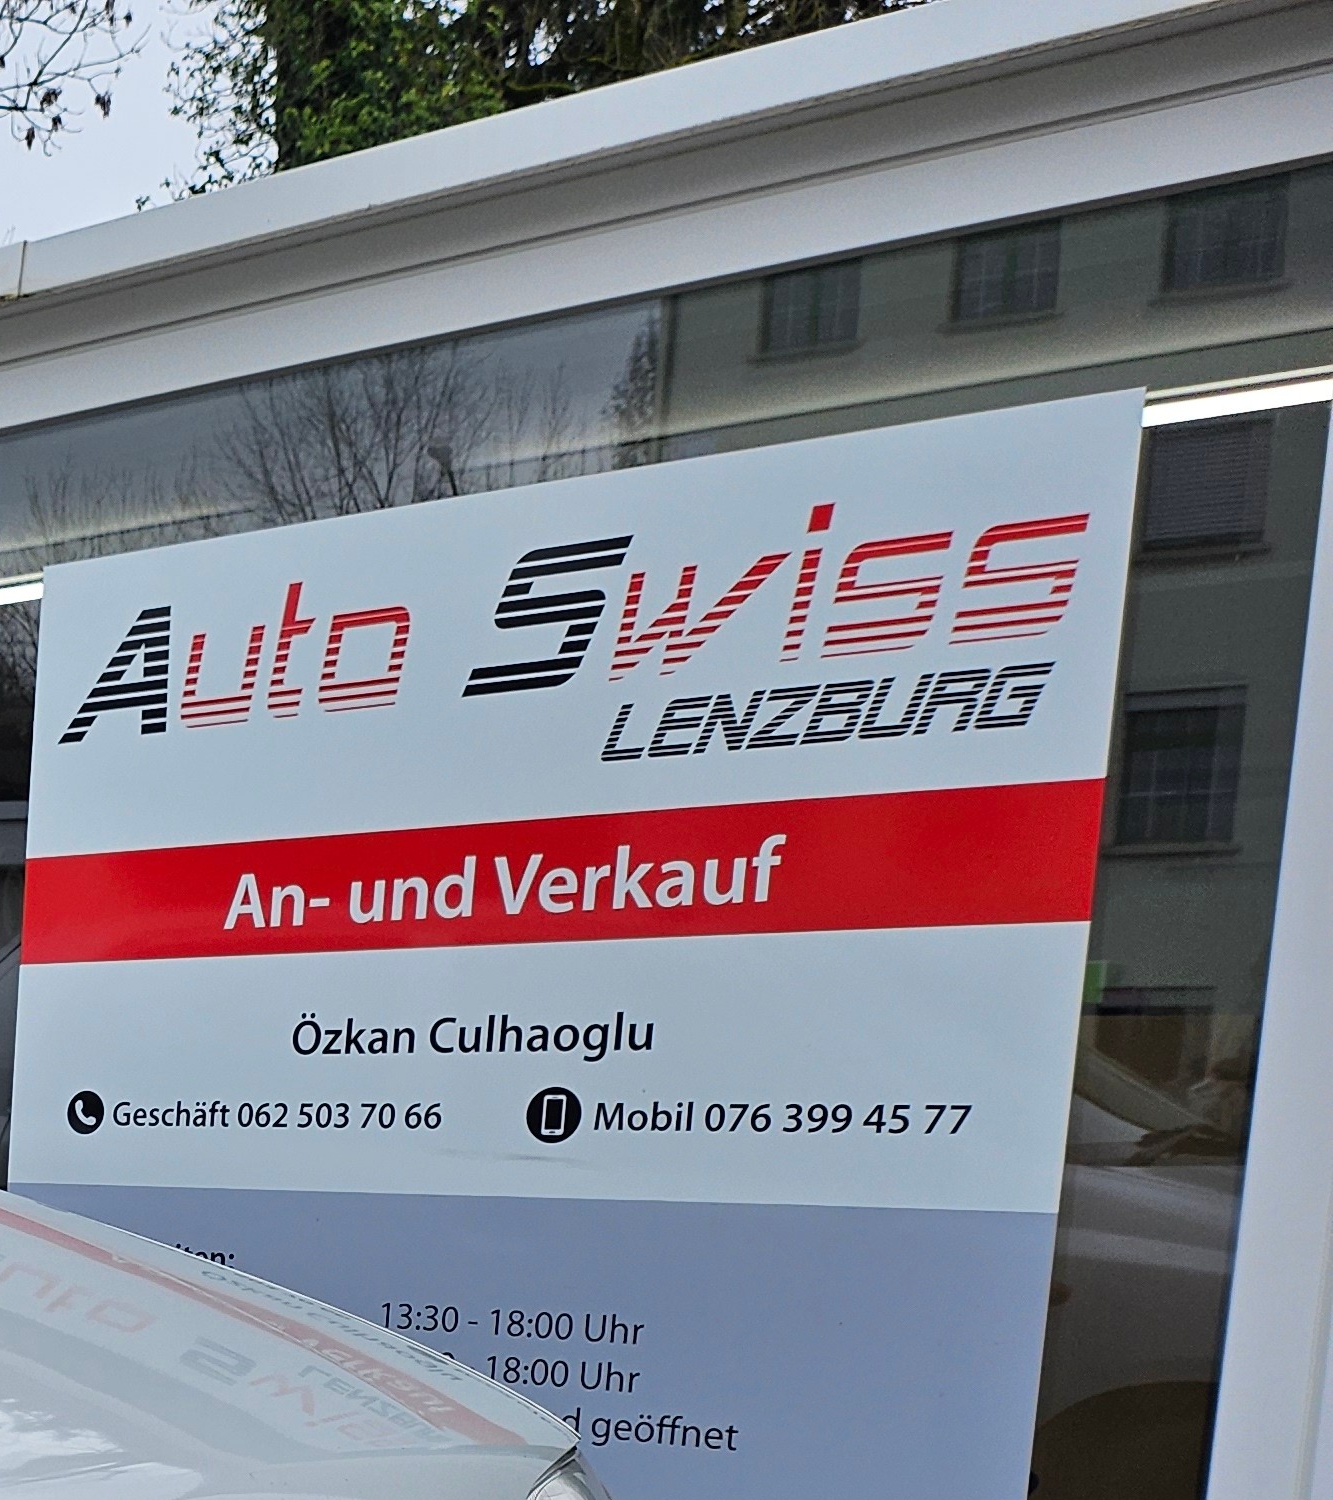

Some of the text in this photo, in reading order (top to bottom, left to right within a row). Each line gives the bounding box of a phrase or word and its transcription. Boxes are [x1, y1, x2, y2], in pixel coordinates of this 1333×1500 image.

[57, 503, 1091, 745] Auto Swiss
[600, 661, 1056, 762] LENZBURG
[224, 834, 786, 930] An- und Verkauf
[292, 1011, 654, 1063] Özkan Culhaoglu
[112, 1100, 442, 1130] Geschäft 062 503 70 66
[593, 1101, 973, 1135] Mobil 076 399 45 77
[381, 1302, 459, 1333] 13:30
[490, 1308, 574, 1341] 18:00
[584, 1313, 645, 1345] Uhr
[486, 1355, 569, 1388] 18:00
[580, 1361, 641, 1394] Uhr
[591, 1413, 740, 1453] geöffnet
